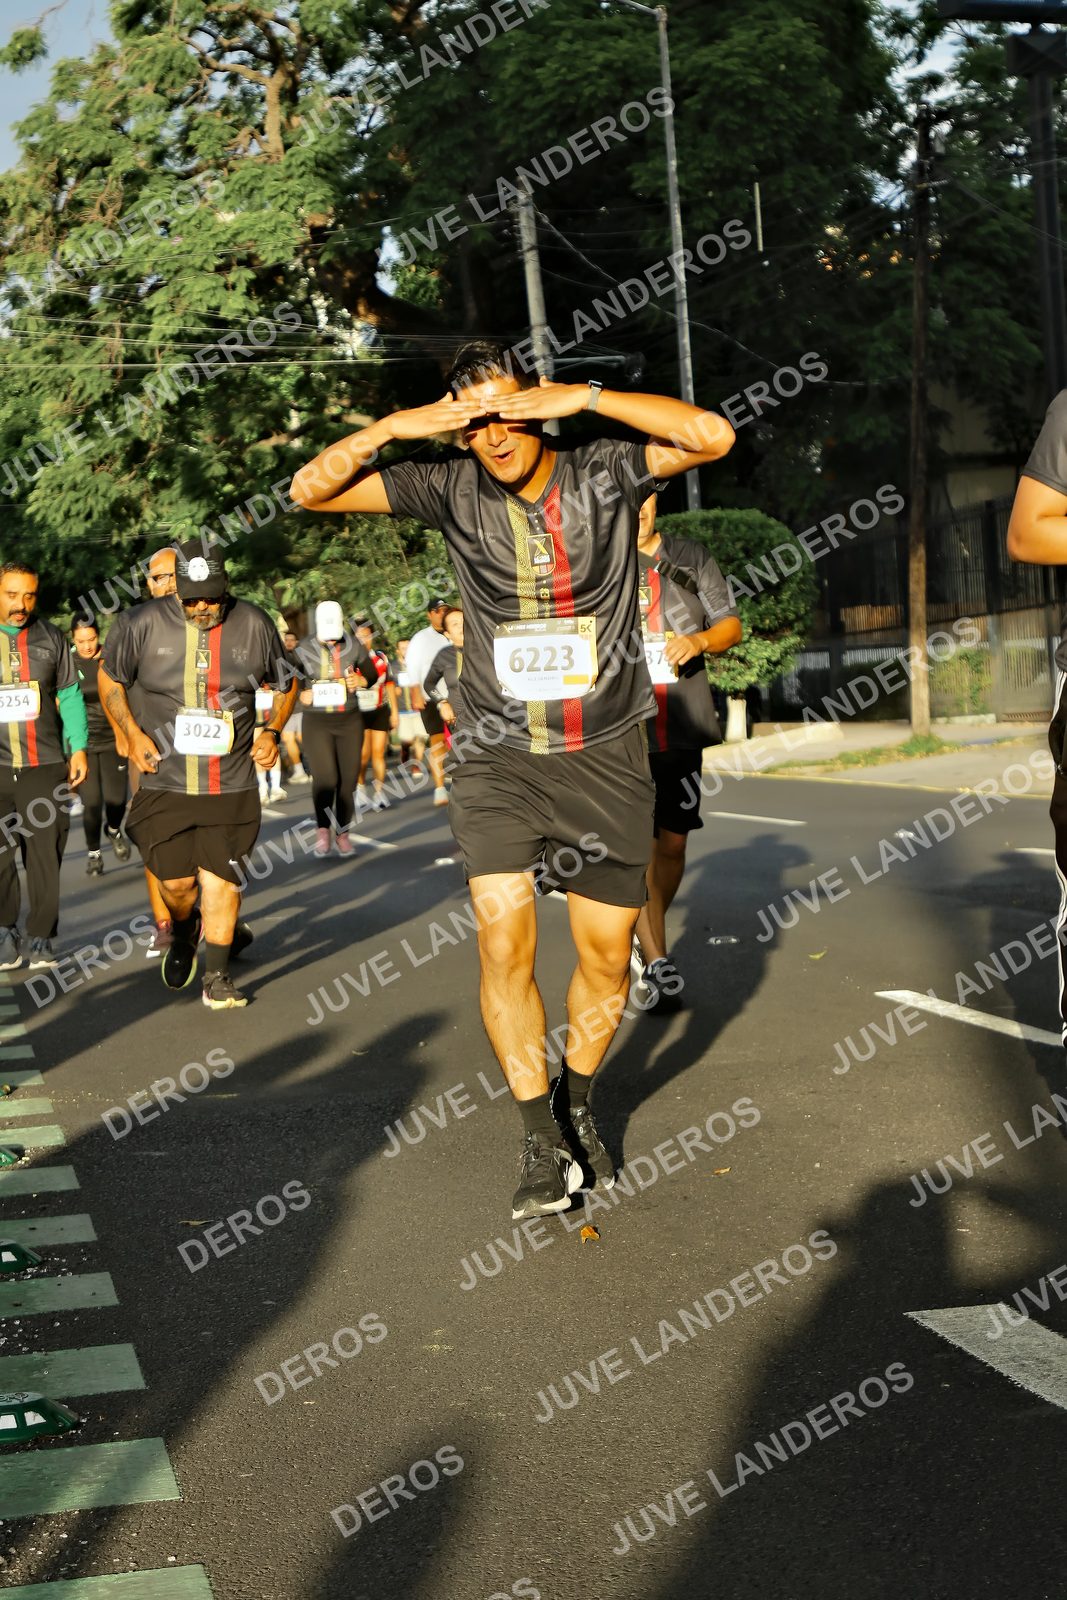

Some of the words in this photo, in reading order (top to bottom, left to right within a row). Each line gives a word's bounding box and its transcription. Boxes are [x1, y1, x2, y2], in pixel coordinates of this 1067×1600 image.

[508, 645, 574, 673] 6223
[645, 650, 668, 665] 37
[183, 722, 222, 739] 3022
